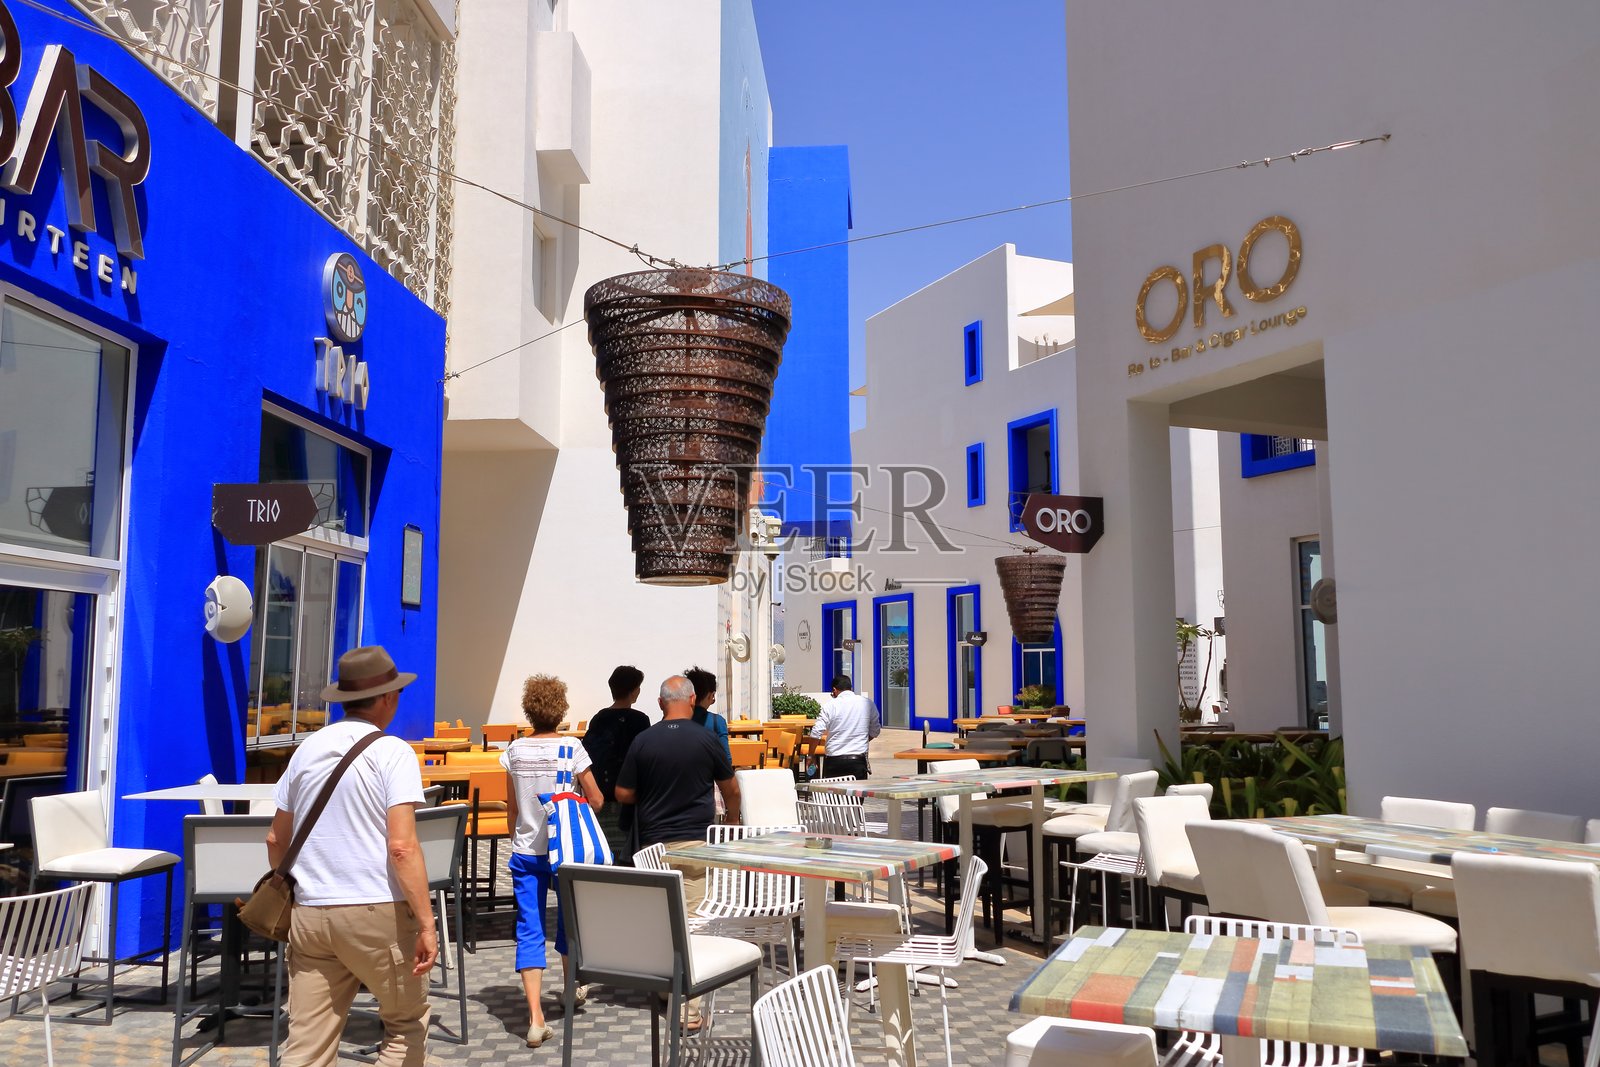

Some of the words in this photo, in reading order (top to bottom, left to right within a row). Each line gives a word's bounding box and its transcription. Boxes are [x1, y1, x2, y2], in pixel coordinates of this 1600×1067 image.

[1135, 215, 1303, 345] ORO
[1171, 344, 1194, 363] Bar
[1195, 339, 1207, 353] &
[1208, 326, 1248, 348] Cigar
[1250, 305, 1308, 336] Lounge
[314, 336, 370, 411] TRIO
[247, 499, 281, 523] TRIO
[1035, 507, 1093, 535] ORO
